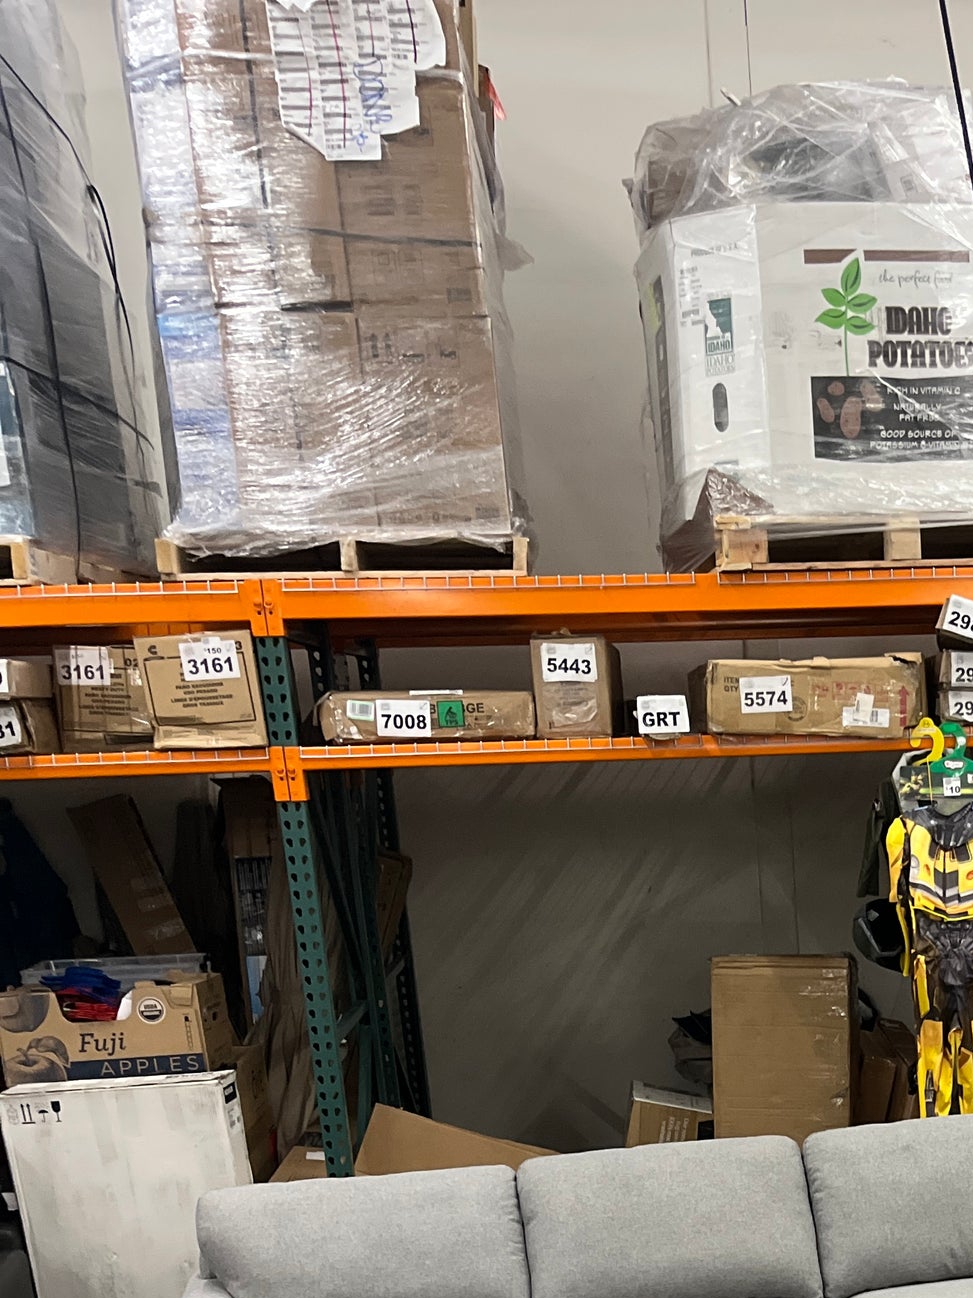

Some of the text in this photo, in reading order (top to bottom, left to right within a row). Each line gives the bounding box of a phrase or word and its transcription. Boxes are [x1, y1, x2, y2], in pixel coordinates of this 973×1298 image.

[879, 269, 895, 284] the
[897, 271, 930, 289] perfect
[708, 340, 731, 353] IDAHO
[887, 386, 908, 395] RCH
[910, 386, 920, 395] IN
[921, 386, 952, 395] VITAMIN
[900, 413, 916, 422] FAT
[880, 430, 906, 438] GOOD
[908, 430, 942, 438] SOURCE
[870, 440, 918, 450] POTASSIUM
[61, 664, 104, 680] 3161
[188, 656, 234, 675] 3161
[547, 658, 592, 675] 5443
[744, 690, 788, 707] 5574
[381, 714, 427, 730] 7008
[642, 712, 680, 727] GRT
[79, 1032, 126, 1056] Fuji
[101, 1055, 199, 1076] APPLES
